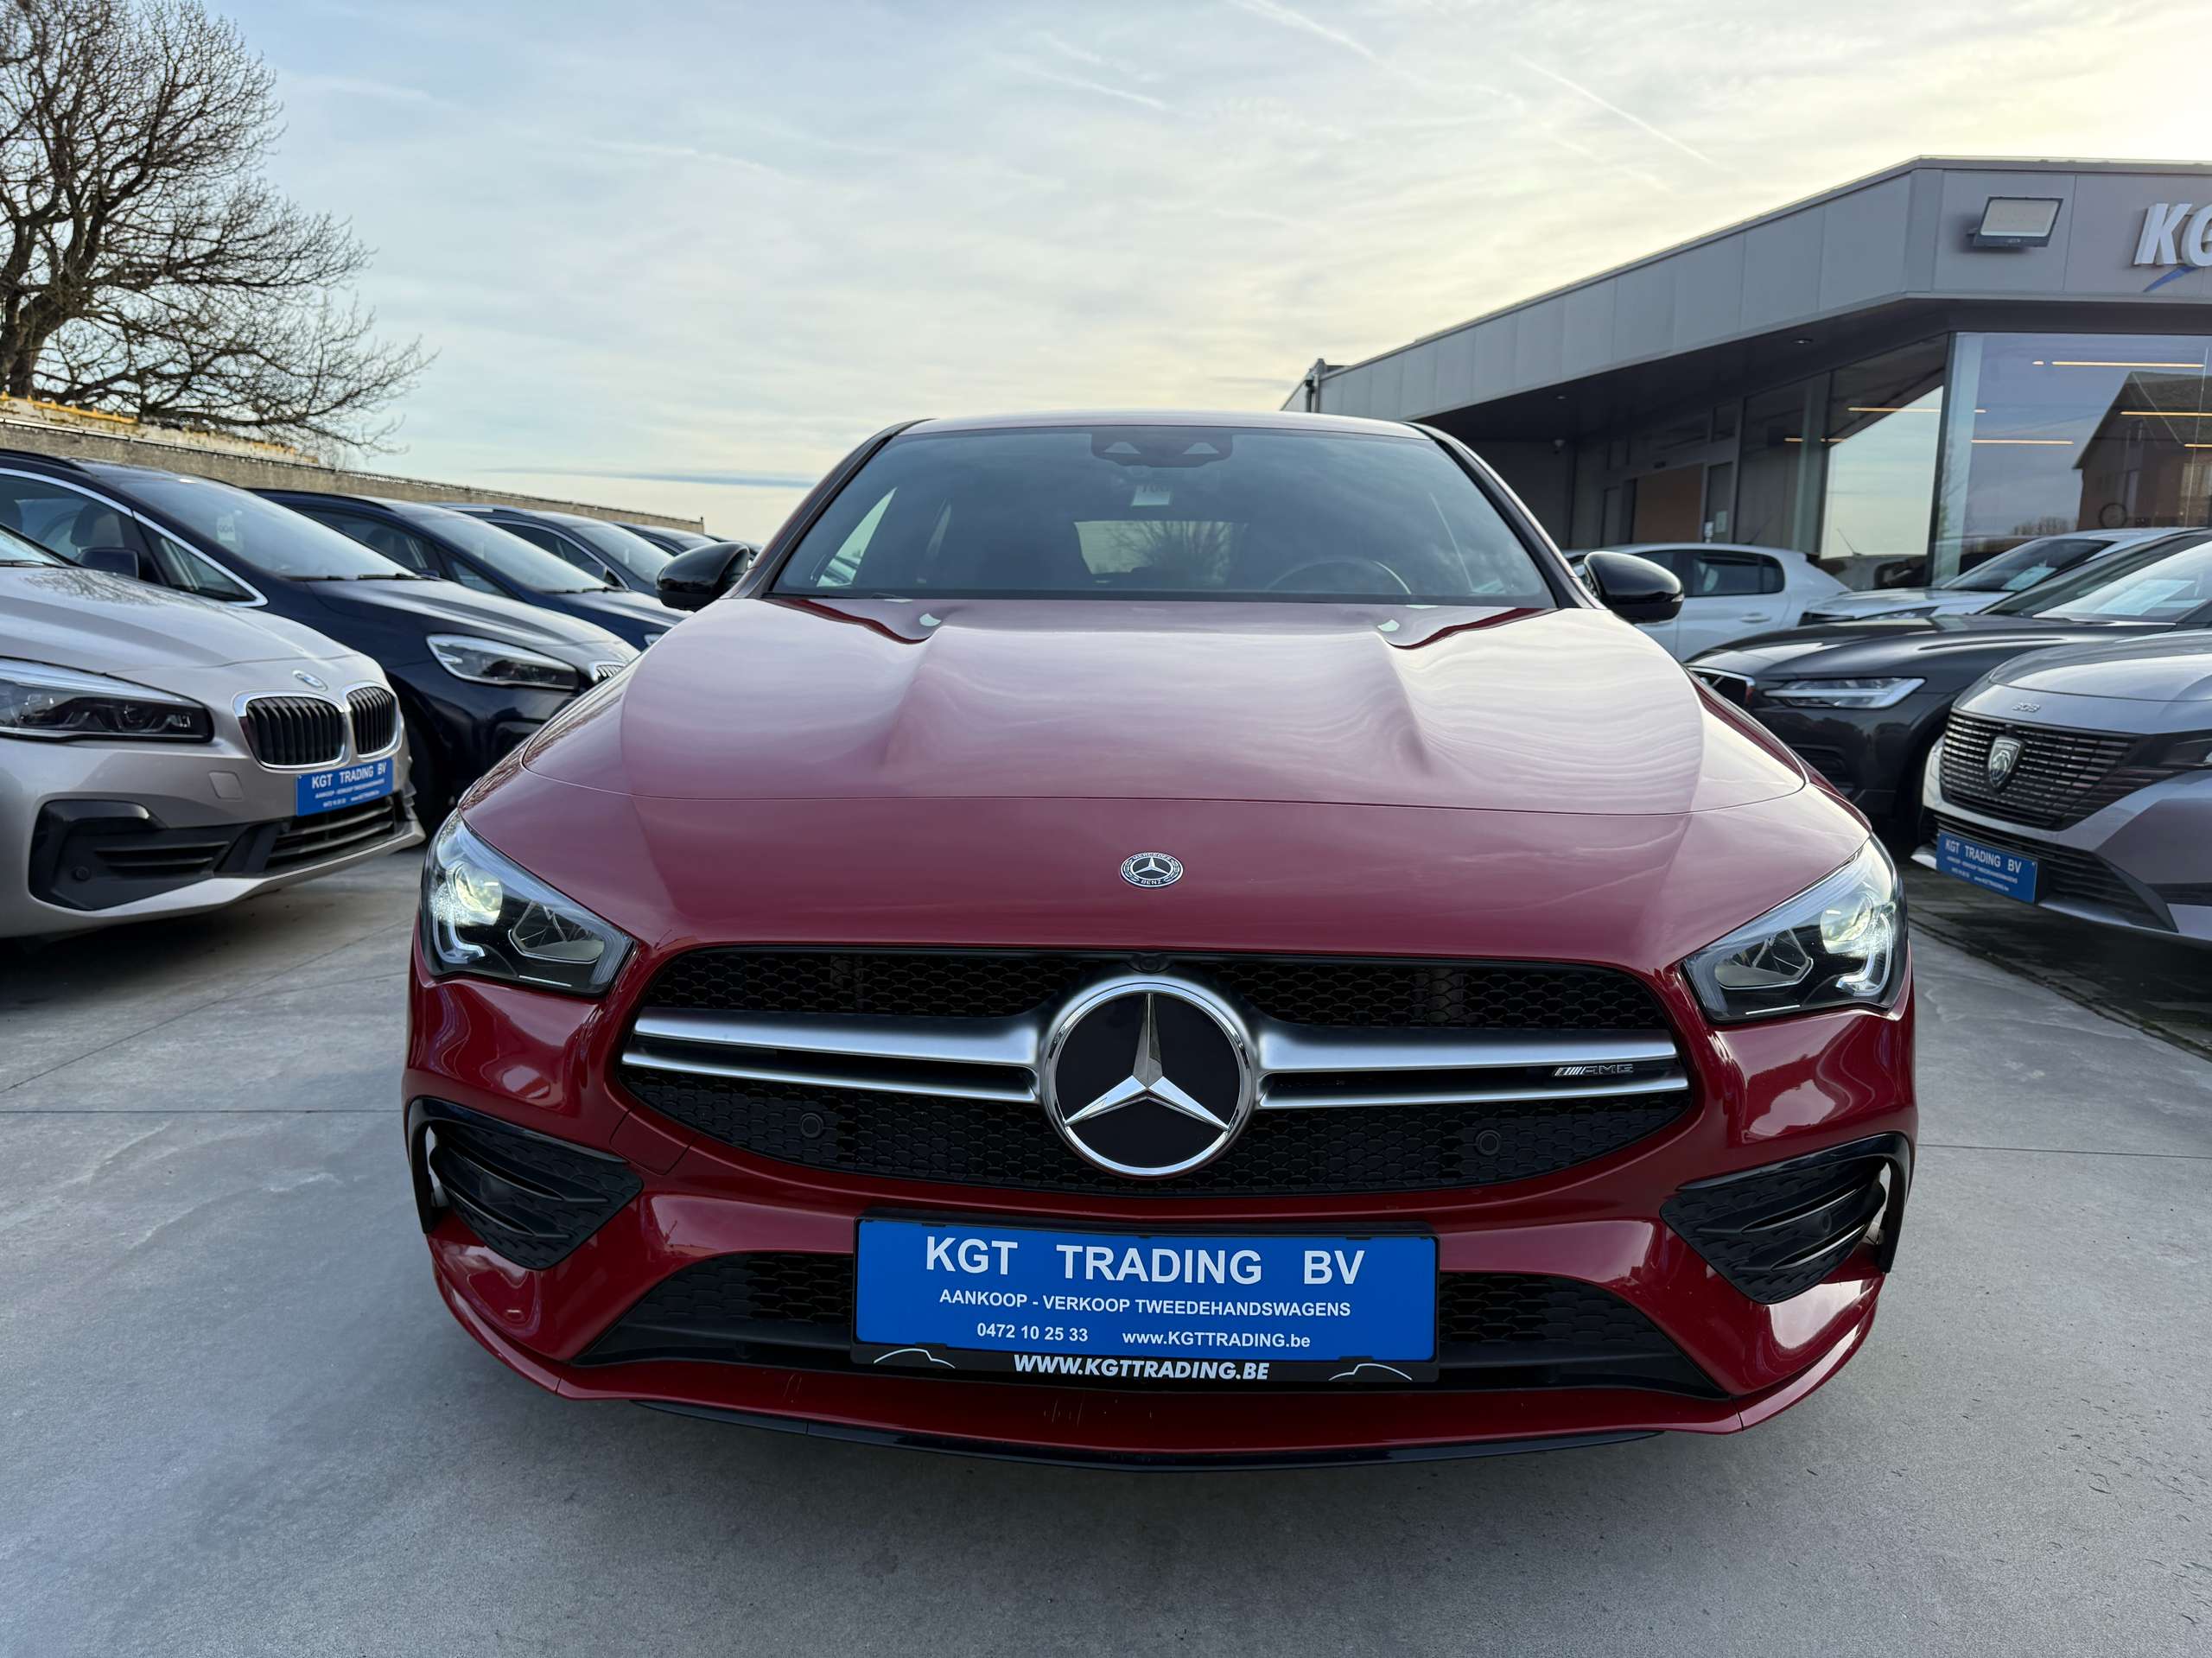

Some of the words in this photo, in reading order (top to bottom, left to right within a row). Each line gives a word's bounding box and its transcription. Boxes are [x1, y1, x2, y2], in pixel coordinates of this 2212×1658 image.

[311, 773, 333, 789] KGT
[339, 765, 373, 784] TRADING
[378, 762, 386, 775] BV
[1944, 839, 1960, 854] KGT
[1965, 845, 2001, 867] TRADING
[2008, 859, 2022, 873] BV
[926, 1236, 1018, 1275] KGT
[1056, 1244, 1262, 1285] TRADING
[1303, 1250, 1365, 1285] BV
[939, 1289, 1027, 1308] AANKOOP
[1043, 1295, 1130, 1313] VERKOOP
[1135, 1299, 1351, 1317] TWEEDEHANDSWAGENS
[977, 1323, 1015, 1338] 0472
[1020, 1325, 1039, 1340] 10
[1044, 1326, 1065, 1341] 25
[1068, 1328, 1088, 1342] 33
[1122, 1331, 1311, 1348] www.KGTTRADING.be
[1014, 1354, 1269, 1381] WWW.KGTTRADING.BE
